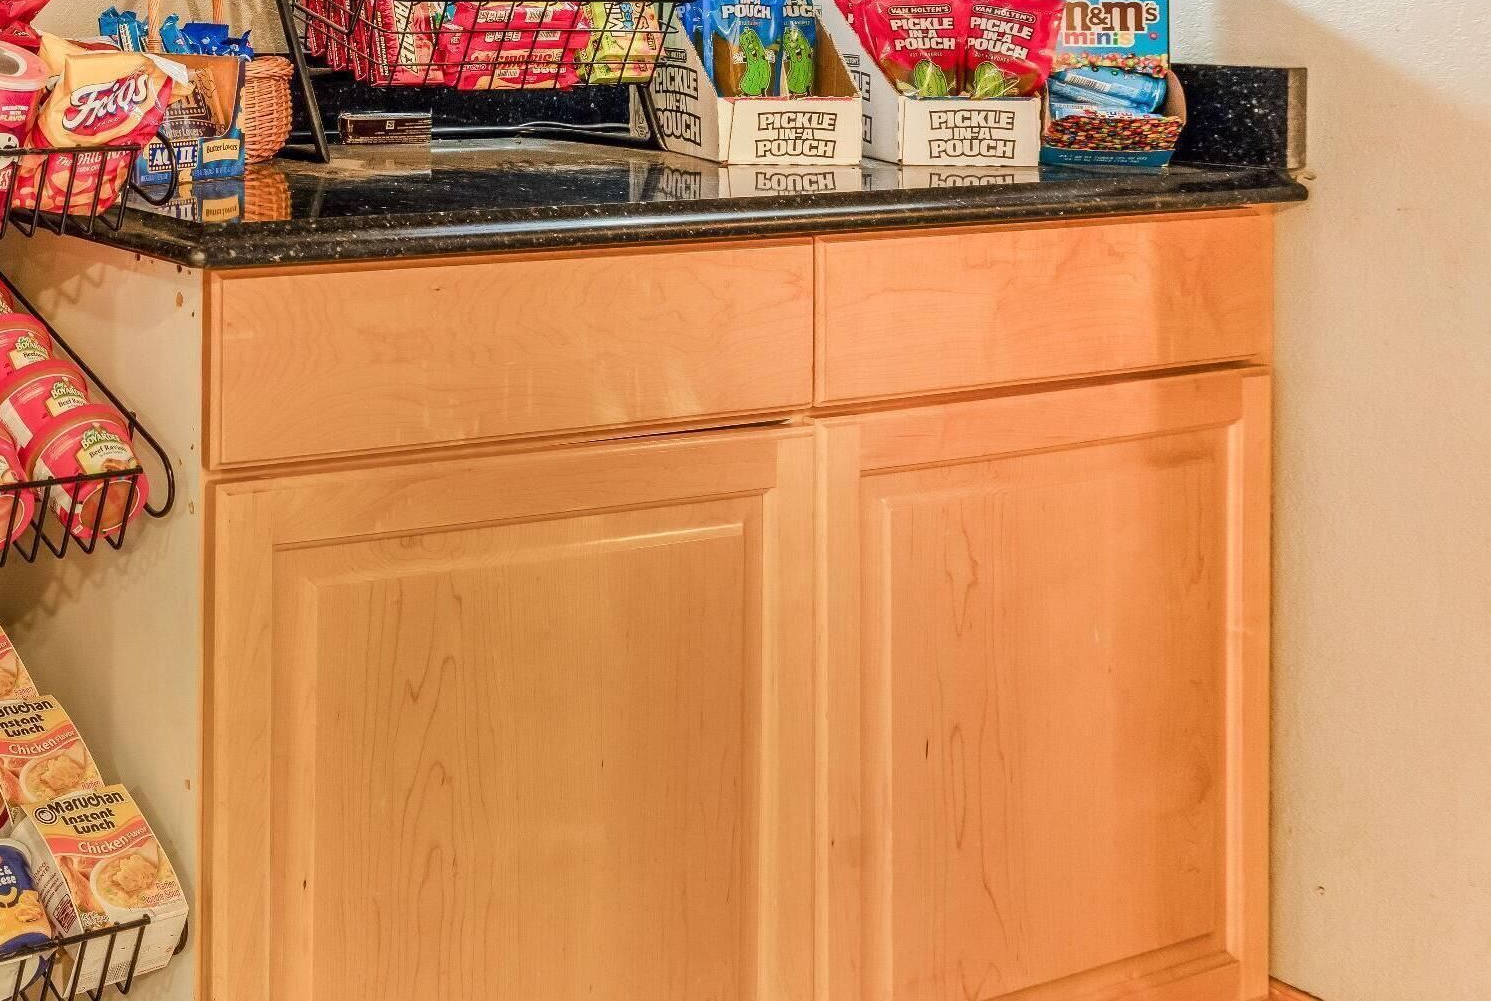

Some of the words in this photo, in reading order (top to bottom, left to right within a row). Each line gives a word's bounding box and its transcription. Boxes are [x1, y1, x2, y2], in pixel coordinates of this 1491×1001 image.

[720, 4, 772, 19] POUCH
[911, 5, 949, 13] HOLTEN'S
[994, 8, 1033, 22] HOLTEN'S
[890, 18, 954, 30] PICKLE
[970, 16, 1034, 40] PICKLE
[895, 38, 956, 50] POUCH
[983, 31, 1012, 42] IN-A
[1064, 32, 1134, 45] minis
[967, 38, 1028, 60] POUCH
[655, 66, 699, 100] PICKLE
[62, 74, 149, 131] Fritos
[758, 111, 837, 131] PICKLE
[928, 109, 1015, 131] PICKLE
[778, 129, 814, 139] IN-A
[952, 127, 993, 140] IN-A
[206, 144, 221, 154] Butter
[222, 142, 238, 152] Lovers
[755, 139, 836, 158] POUCH
[928, 139, 1016, 160] POUCH
[81, 432, 120, 448] BOYARDEE
[88, 448, 104, 458] Beef
[4, 725, 45, 738] Lunch
[9, 738, 56, 754] Chicken
[56, 731, 76, 745] Flavor
[46, 791, 125, 816] Maruchan
[61, 808, 115, 826] Instant
[73, 819, 115, 835] Lunch
[78, 835, 128, 855] Chicken
[127, 826, 147, 840] Flavor
